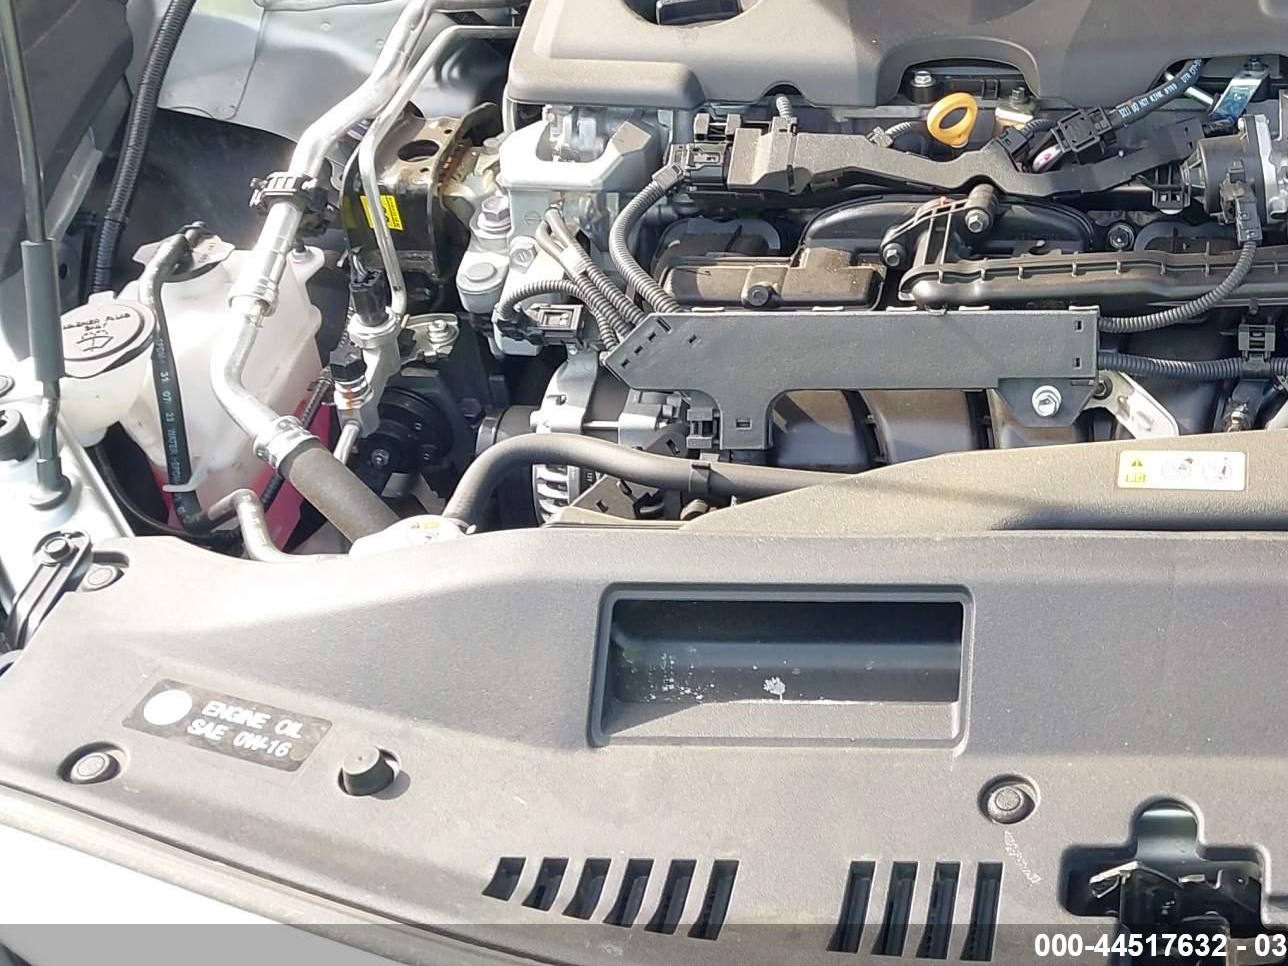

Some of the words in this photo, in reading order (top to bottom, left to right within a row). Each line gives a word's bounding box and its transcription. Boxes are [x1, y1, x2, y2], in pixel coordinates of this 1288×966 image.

[187, 718, 229, 740] SAE
[233, 731, 292, 757] 0W-16
[201, 700, 271, 729] ENGINE
[274, 719, 303, 739] OIL
